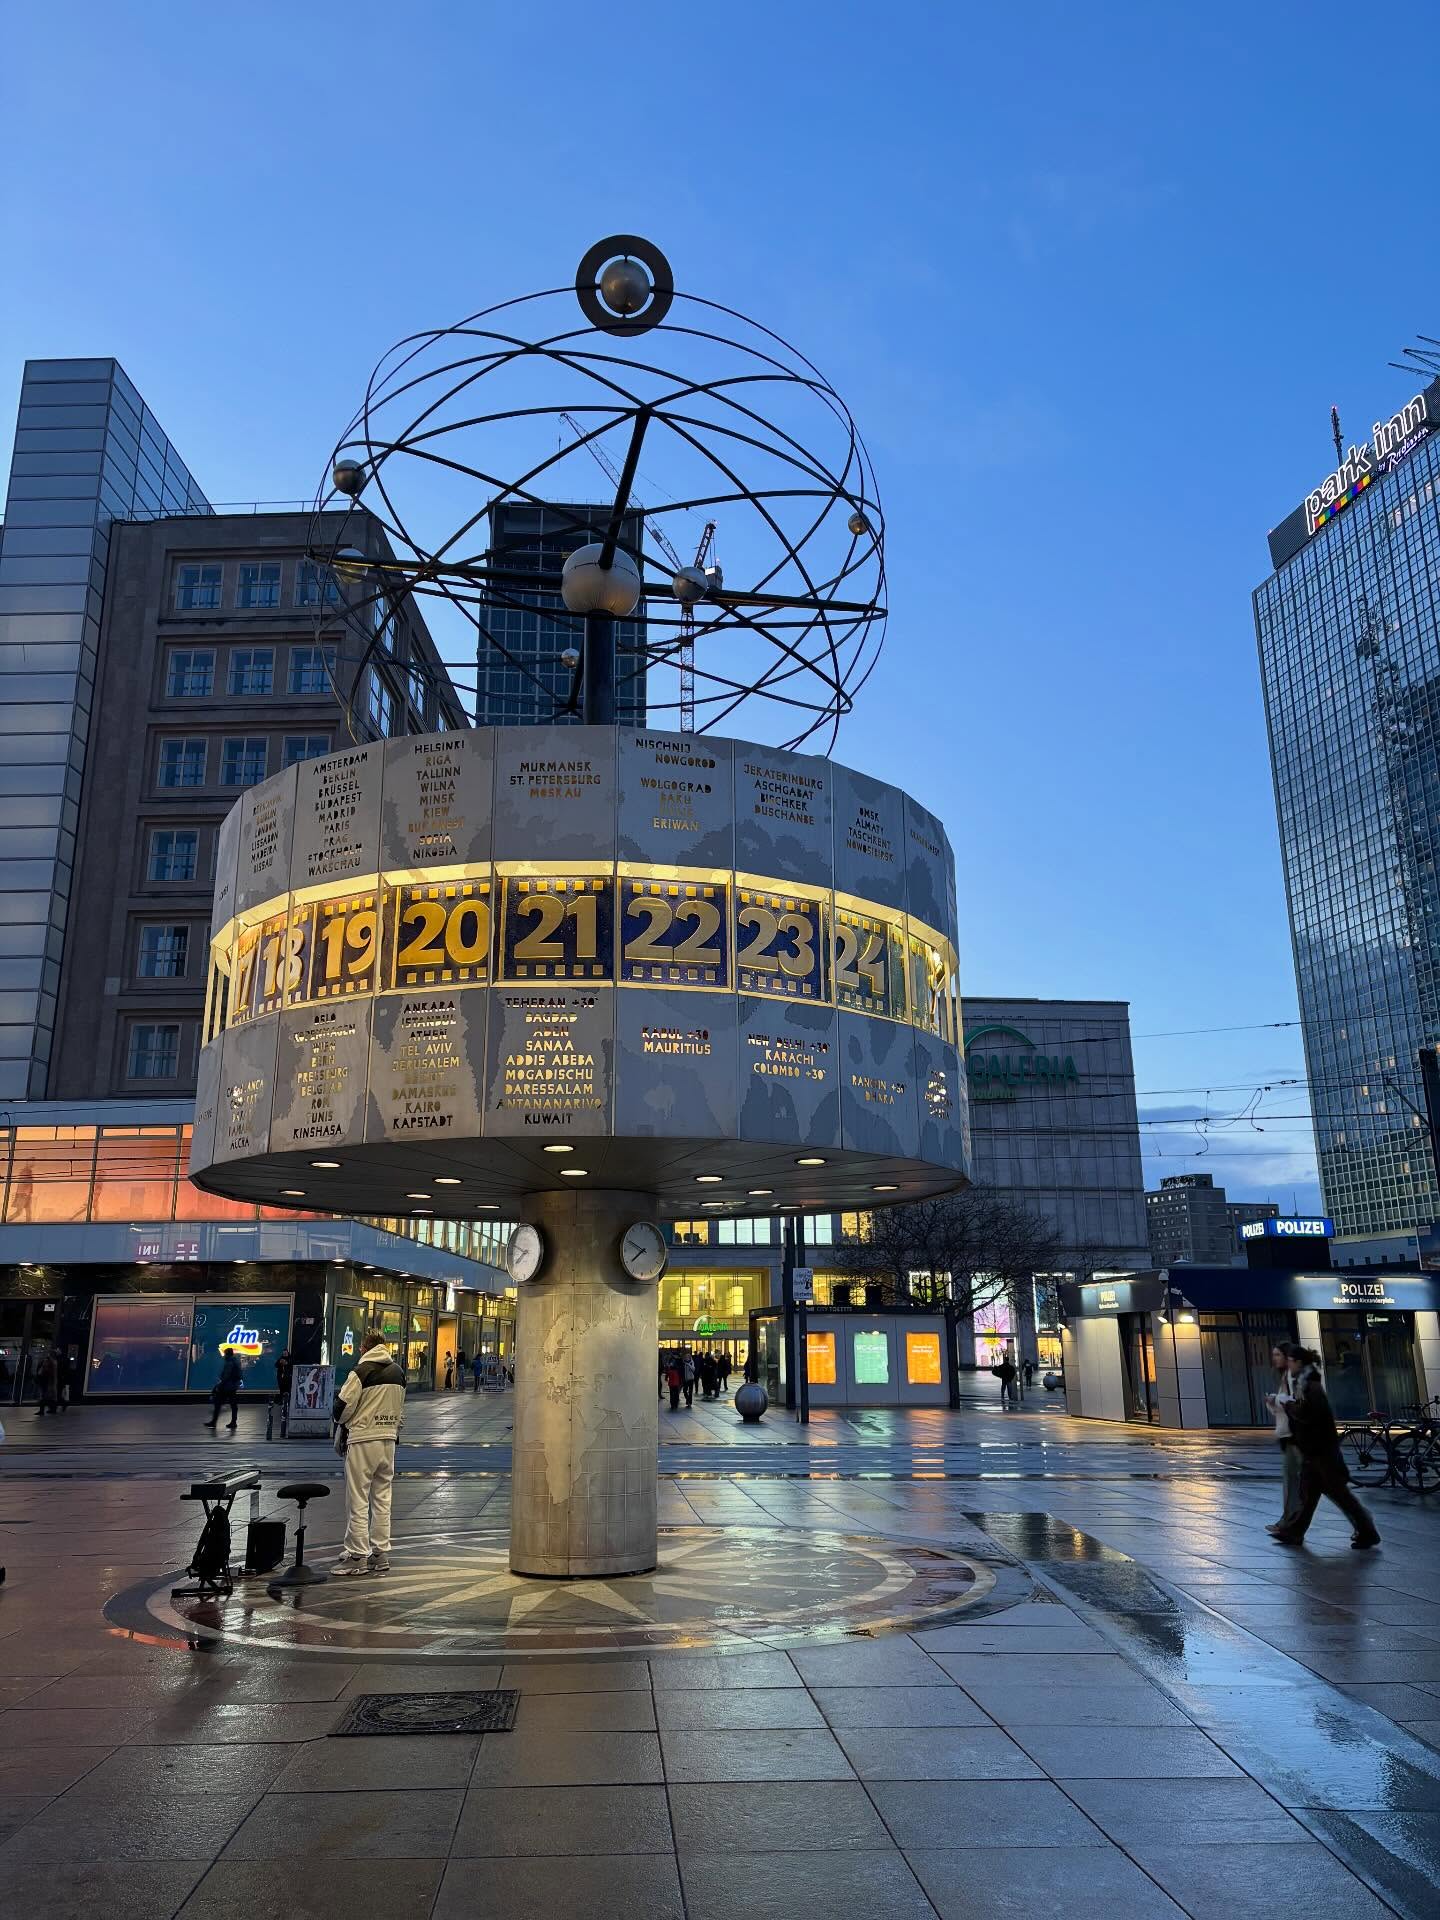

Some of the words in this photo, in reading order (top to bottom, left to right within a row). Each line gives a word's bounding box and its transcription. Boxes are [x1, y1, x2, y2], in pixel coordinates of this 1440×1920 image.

[1305, 443, 1372, 536] park
[1373, 394, 1427, 460] inn
[414, 740, 465, 754] HELSINKI
[635, 738, 691, 753] NISCHNIJ
[313, 752, 368, 775] AMSTERDAM
[425, 755, 452, 767] RIGA
[520, 761, 592, 772] MURMANSK
[655, 754, 716, 768] NOWGOROD
[323, 768, 357, 785] BERLIN
[416, 766, 461, 780] TALLINN
[510, 775, 525, 785] ST.
[528, 775, 601, 785] PETERSBURG
[744, 764, 823, 790] JEKATERINBURG
[318, 780, 360, 799] BRÜSSEL
[420, 781, 455, 792] WILNA
[529, 787, 582, 798] MOSKAU
[641, 778, 712, 793] WOLGOGRAD
[755, 780, 814, 800] ASCHGABAT
[315, 792, 363, 811] BUDAPEST
[420, 793, 455, 806] MINSK
[319, 806, 356, 823] MADRID
[423, 806, 450, 819] KIEW
[755, 805, 815, 825] DUSCHANBE
[860, 808, 880, 821] OMSK
[255, 820, 277, 838] LONDON
[324, 820, 350, 835] PARIS
[653, 817, 700, 831] ERIWAN
[251, 831, 279, 851] LISSABON
[323, 834, 348, 848] PRAG
[419, 833, 452, 845] SOFIA
[251, 845, 278, 862] MADEIRA
[308, 843, 363, 861] STOCKHOLM
[413, 846, 458, 860] NIKOSIA
[253, 857, 273, 873] BISSAU
[308, 857, 361, 877] WARSCHAU
[398, 900, 490, 966] 20
[514, 895, 598, 960] 21
[625, 897, 721, 964] 22
[322, 911, 377, 979] 19
[737, 908, 815, 976] 23
[263, 928, 304, 997] 18
[829, 924, 885, 995] 24
[404, 1001, 456, 1013] ANKARA
[505, 997, 566, 1008] TEHERAN
[314, 1013, 336, 1025] OSLO
[402, 1015, 456, 1028] ISTANBUL
[525, 1012, 578, 1023] BAGDAD
[409, 1029, 448, 1041] ATHEN
[533, 1026, 569, 1037] ADEN
[642, 1027, 683, 1040] KABUL
[526, 1040, 574, 1051] SANAA
[644, 1041, 711, 1055] MAURITIUS
[748, 1034, 770, 1046] NEW
[776, 1037, 805, 1050] DELHI
[400, 1045, 419, 1056] TEL
[425, 1043, 452, 1055] AVIV
[506, 1055, 546, 1066] ADDIS
[552, 1055, 594, 1066] ABEBA
[765, 1049, 814, 1065] KARACHI
[392, 1057, 460, 1072] JERUSALEM
[753, 1062, 800, 1078] COLOMBO
[969, 1055, 1079, 1087] GALERIA
[505, 1069, 593, 1080] MOGADISCHU
[505, 1084, 593, 1095] DARESSALAM
[312, 1099, 329, 1110] ROM
[406, 1101, 441, 1114] KAIRO
[496, 1099, 602, 1110] ANTANANARIVO
[306, 1112, 333, 1124] TUNIS
[393, 1115, 453, 1129] KAPSTADT
[525, 1113, 573, 1124] KUWAIT
[293, 1124, 342, 1139] KINSHASA
[1242, 1222, 1265, 1238] POLIZEI
[1276, 1220, 1325, 1234] POLIZEI
[1341, 1283, 1385, 1296] POLIZEI
[228, 1326, 258, 1344] dm
